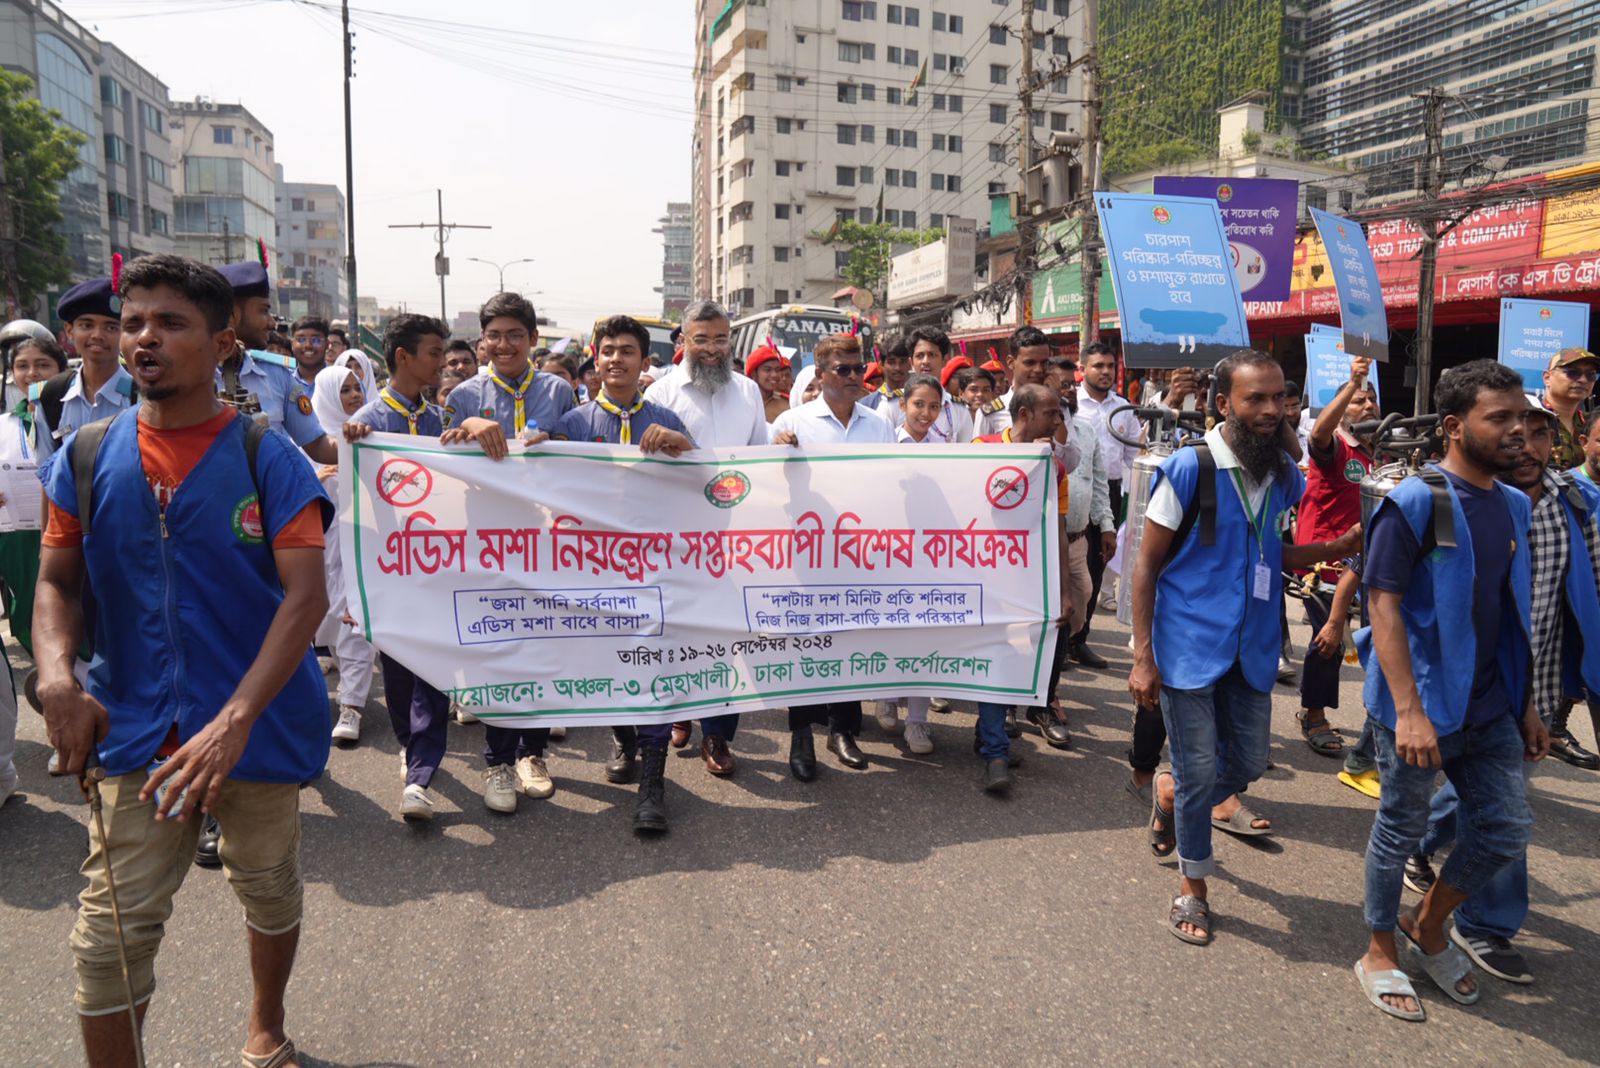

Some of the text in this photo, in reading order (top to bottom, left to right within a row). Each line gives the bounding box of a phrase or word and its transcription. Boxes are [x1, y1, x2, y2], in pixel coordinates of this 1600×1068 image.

[1231, 208, 1260, 219] সচেতন
[1261, 206, 1280, 219] থাকি
[1259, 223, 1274, 236] করি
[1373, 242, 1394, 257] KSD
[1447, 231, 1457, 247] &
[1461, 219, 1529, 246] COMPANY
[1144, 232, 1192, 248] চারপাশ
[1127, 269, 1226, 288] ও মশামুক্ত রাখতে
[1457, 271, 1495, 293] মেসার্স
[1497, 272, 1520, 289] কে
[1522, 269, 1550, 287] এস
[1552, 262, 1574, 285] ডি
[1168, 290, 1192, 304] হবে
[1243, 301, 1284, 316] MPANY
[785, 319, 857, 336] ANABI
[377, 511, 467, 576] এডিস
[476, 528, 541, 573] মশা
[679, 510, 825, 579] সপ্তাহব্যাপী
[832, 511, 915, 571] বিশেষ
[922, 517, 1029, 569] কার্যক্রম
[532, 593, 569, 611] পানি
[576, 592, 637, 611] সর্বনাশা
[818, 592, 841, 607] দশ
[844, 588, 882, 606] মিনিট
[886, 588, 915, 606] প্রতি
[919, 589, 967, 606] শনিবার
[468, 615, 516, 636] এডিস
[520, 616, 555, 632] মশা
[561, 614, 599, 631] বাধে
[755, 610, 782, 628] নিজ
[785, 609, 812, 627] নিজ
[884, 608, 911, 625] করি
[617, 645, 663, 666] তারিখ
[679, 643, 726, 662] ১৯-২৬
[730, 635, 788, 656] সেপ্টেম্বর
[792, 634, 833, 651] ২০২৪
[552, 677, 641, 700] অঞ্চল-৩
[753, 660, 794, 683] ঢাকা
[800, 655, 843, 679] উত্তর
[848, 651, 889, 677] সিটি
[894, 650, 992, 678] কর্পোরেশন
